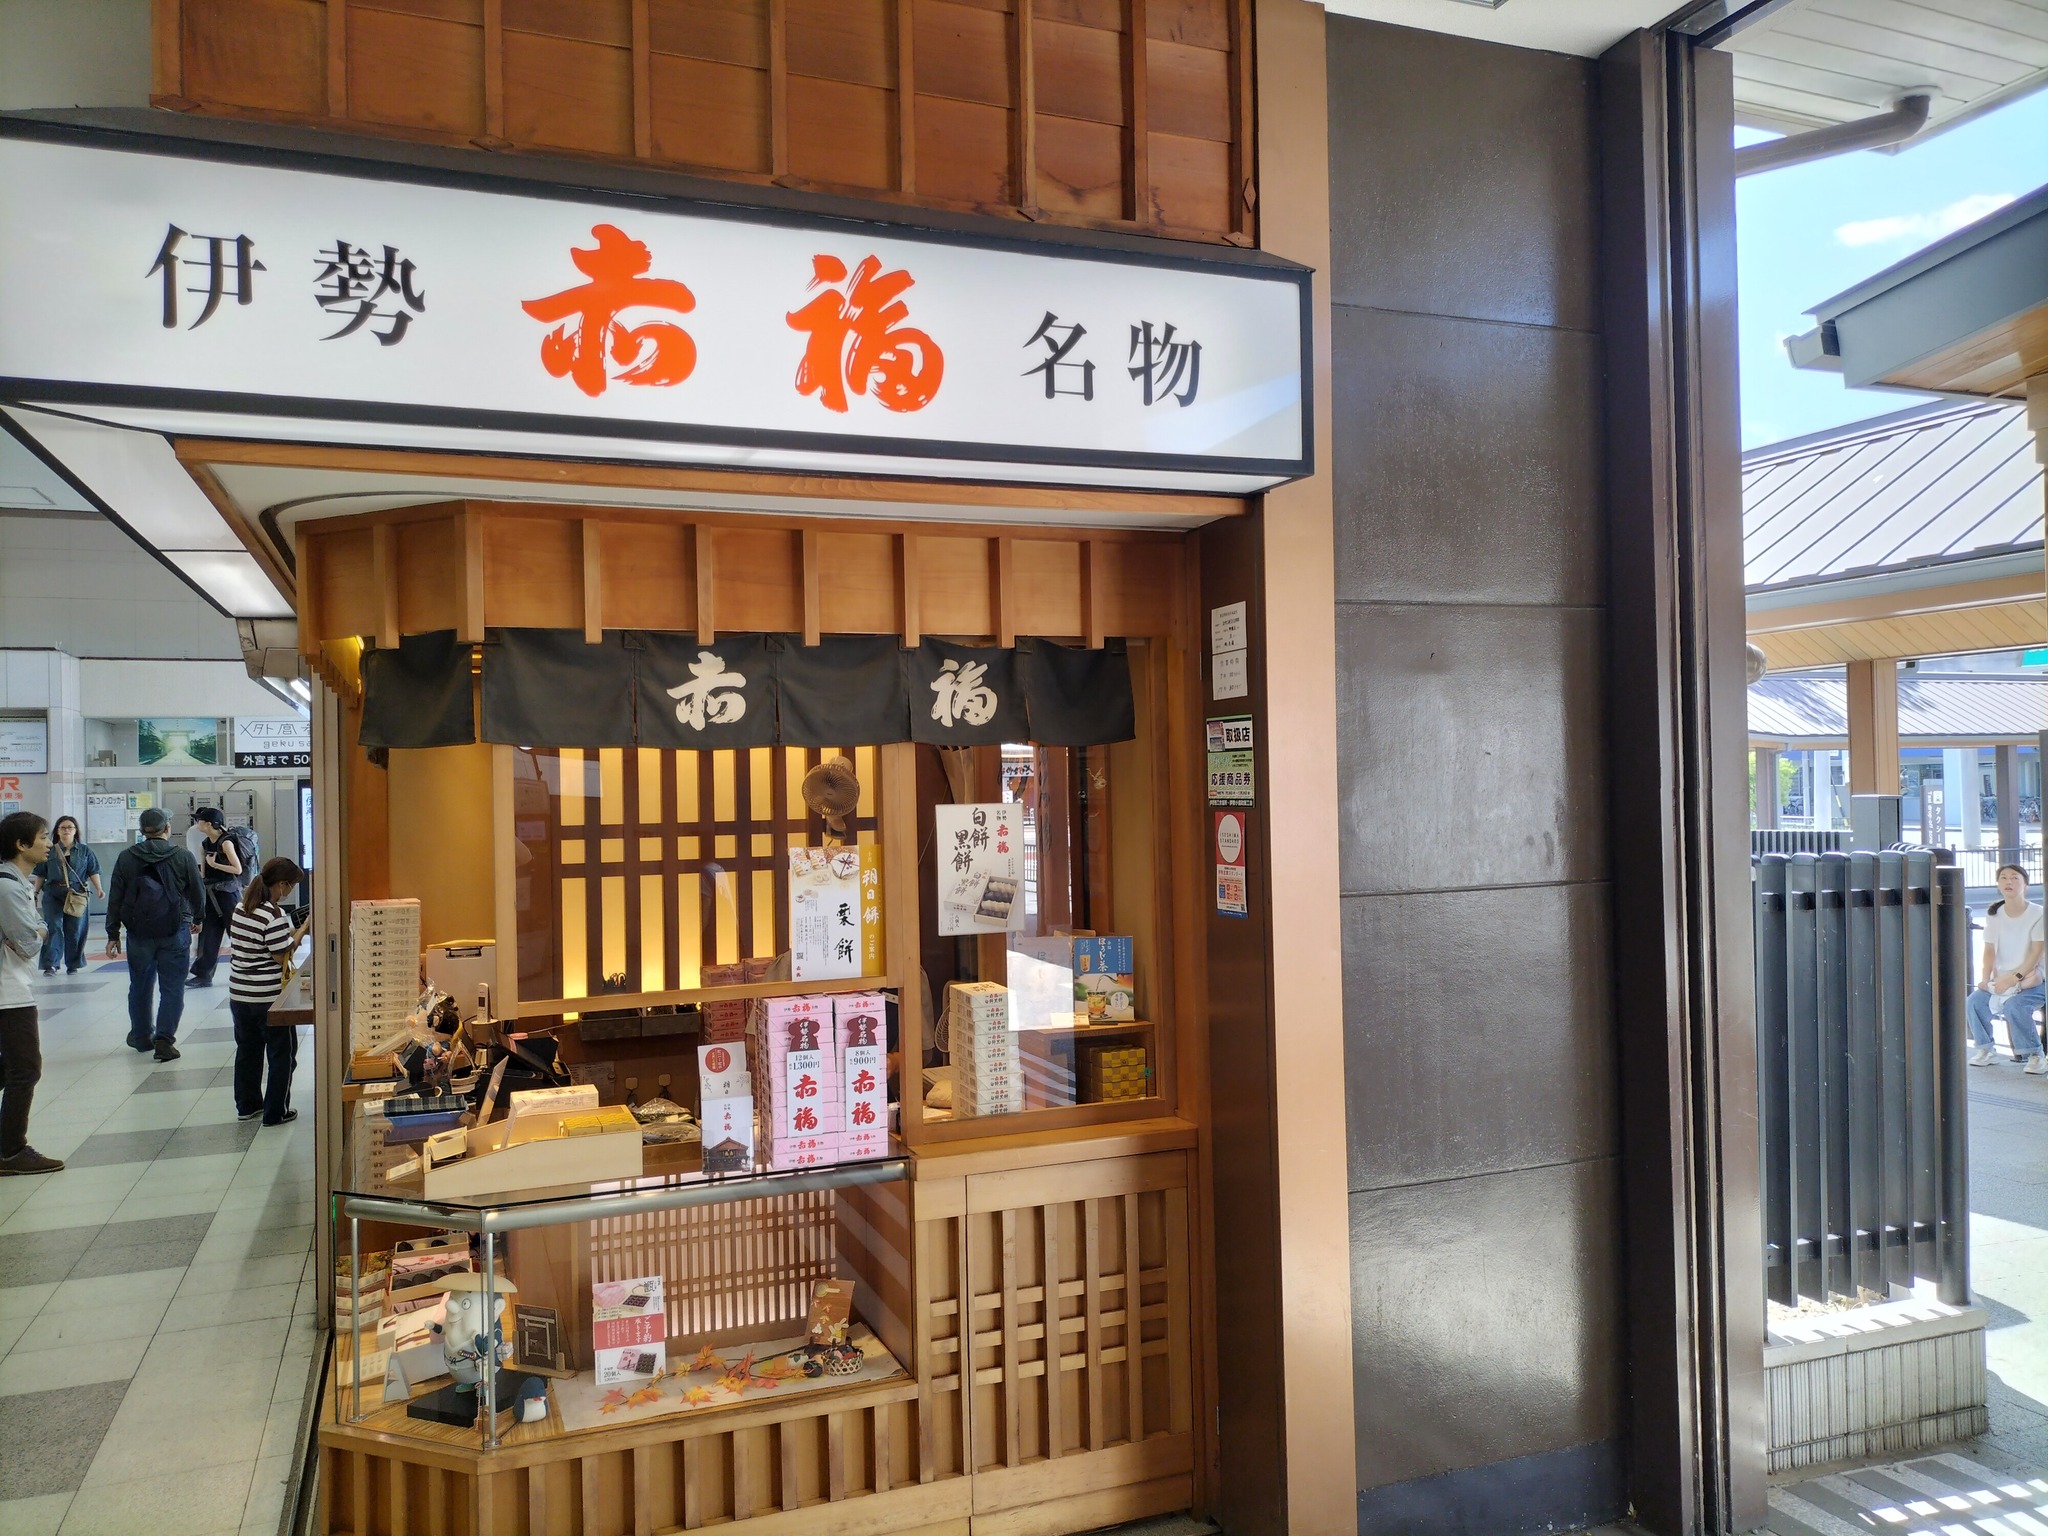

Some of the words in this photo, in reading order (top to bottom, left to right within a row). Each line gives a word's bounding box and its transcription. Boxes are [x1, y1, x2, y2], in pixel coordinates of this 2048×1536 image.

[145, 223, 426, 347] 伊勢
[521, 224, 944, 415] 赤福
[1020, 311, 1202, 408] 名物
[666, 651, 998, 731] 赤福
[263, 739, 295, 749] geku
[1225, 726, 1250, 743] 取扱店
[242, 755, 289, 766] 外宮まで
[1211, 772, 1251, 786] 応援商品券
[96, 797, 125, 805] コインロッカー
[969, 807, 990, 852] 白餅
[996, 824, 1009, 854] 赤福
[951, 829, 973, 874] 黒餅
[862, 868, 879, 925] 朔日餅
[834, 902, 855, 964] 栗餅
[1098, 938, 1108, 972] ほうじ茶
[792, 1074, 818, 1132] 赤福
[851, 1069, 876, 1126] 赤福
[643, 1316, 652, 1342] ご予約
